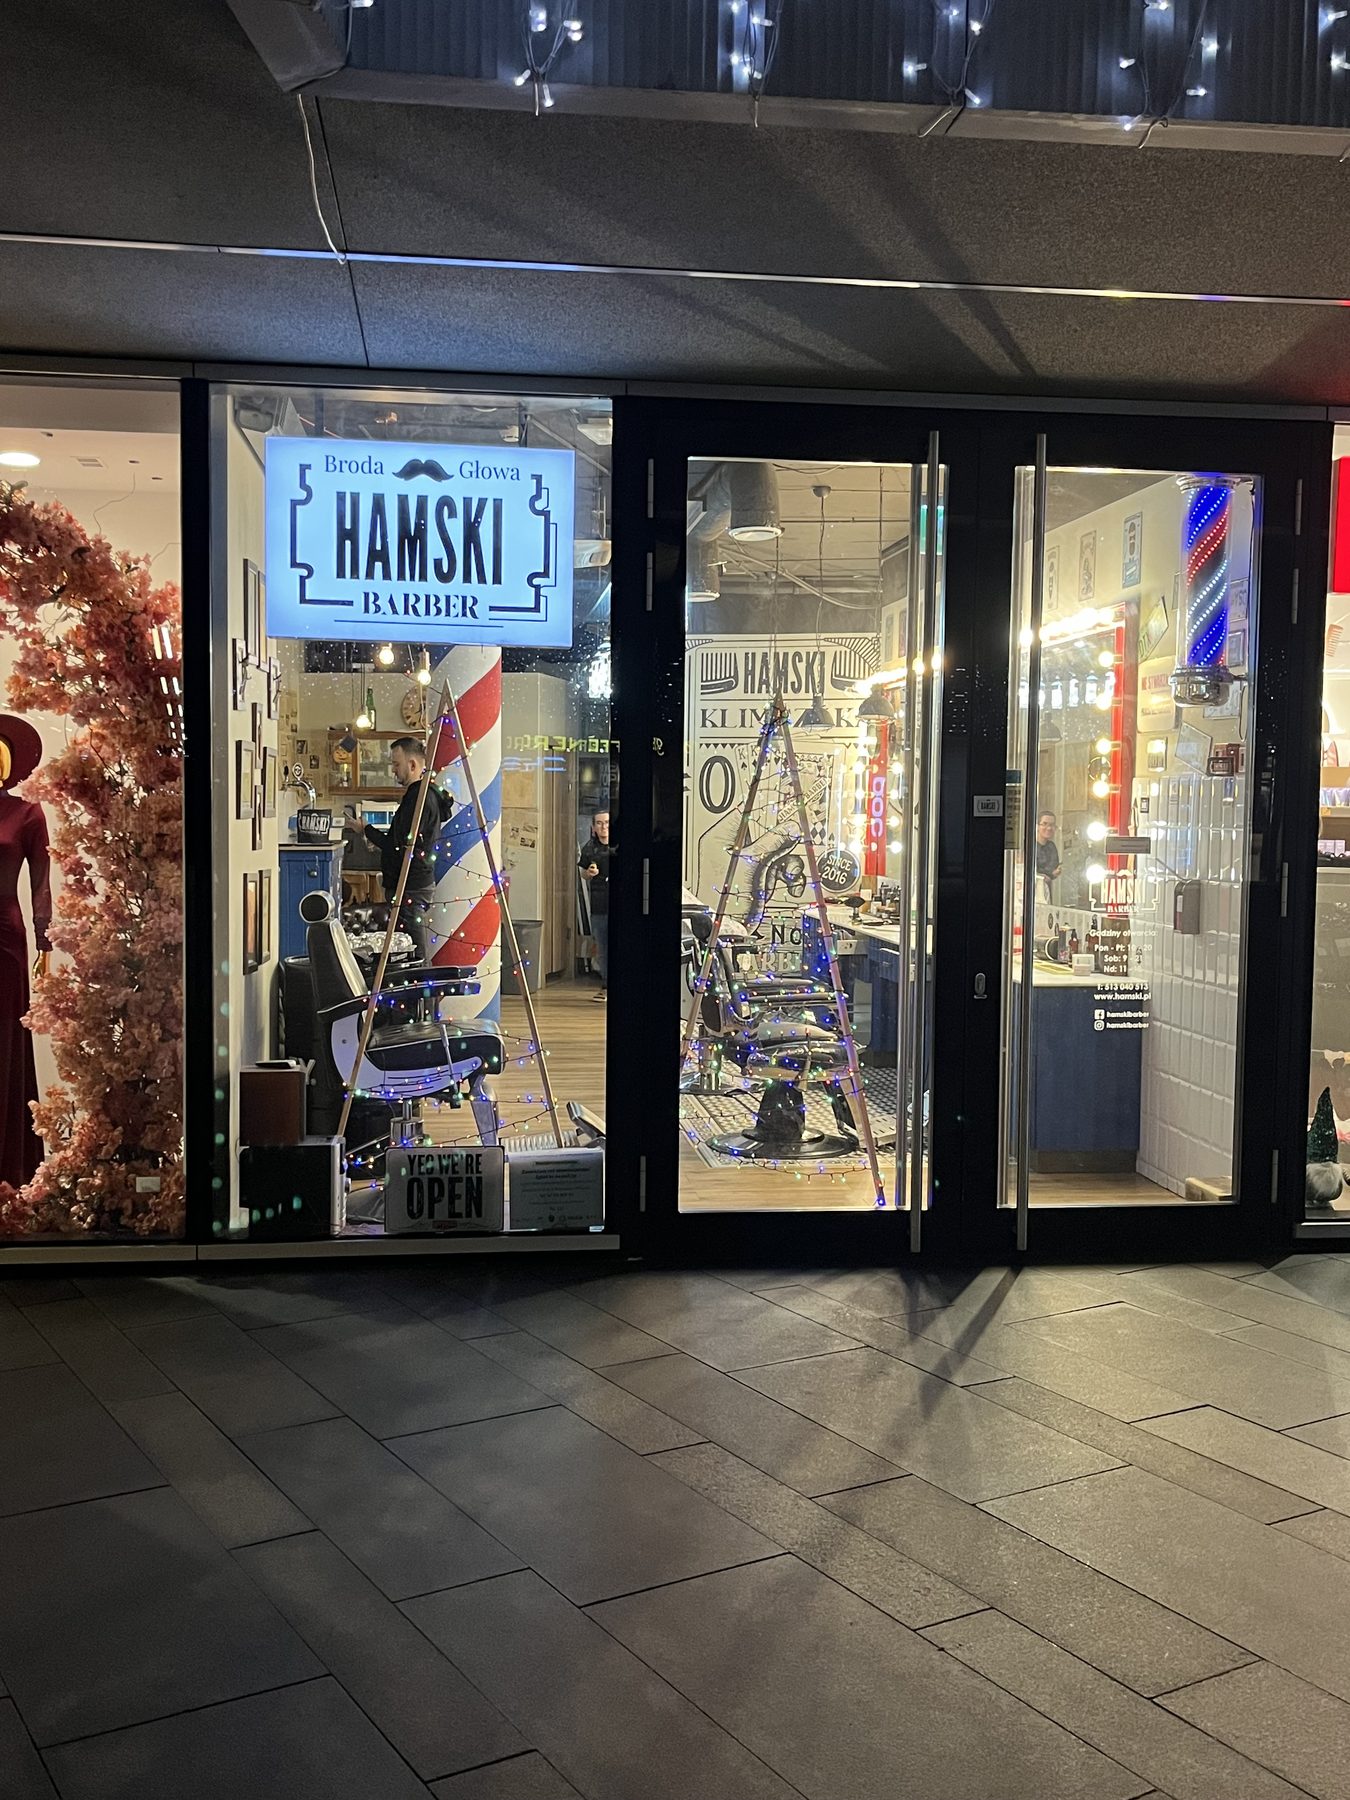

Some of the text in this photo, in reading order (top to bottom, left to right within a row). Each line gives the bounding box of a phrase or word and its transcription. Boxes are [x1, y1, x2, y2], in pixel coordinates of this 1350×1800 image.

[324, 455, 520, 481] Broda Głowa
[335, 491, 503, 585] HAMSKI
[362, 591, 480, 620] BARBER
[743, 651, 826, 694] HAMSKI
[827, 855, 853, 871] SINCE
[822, 866, 848, 884] 2016
[1100, 878, 1146, 904] HAMSKI
[1089, 929, 1121, 938] Godziny
[1103, 954, 1121, 962] Sob:
[1122, 954, 1128, 962] 9
[1103, 965, 1117, 973] Nd:
[1119, 965, 1127, 973] 11
[1093, 992, 1152, 1001] www.hamski.pl
[1134, 983, 1149, 991] 513
[406, 1153, 483, 1176] YES WE'RE
[405, 1176, 484, 1220] OPEN
